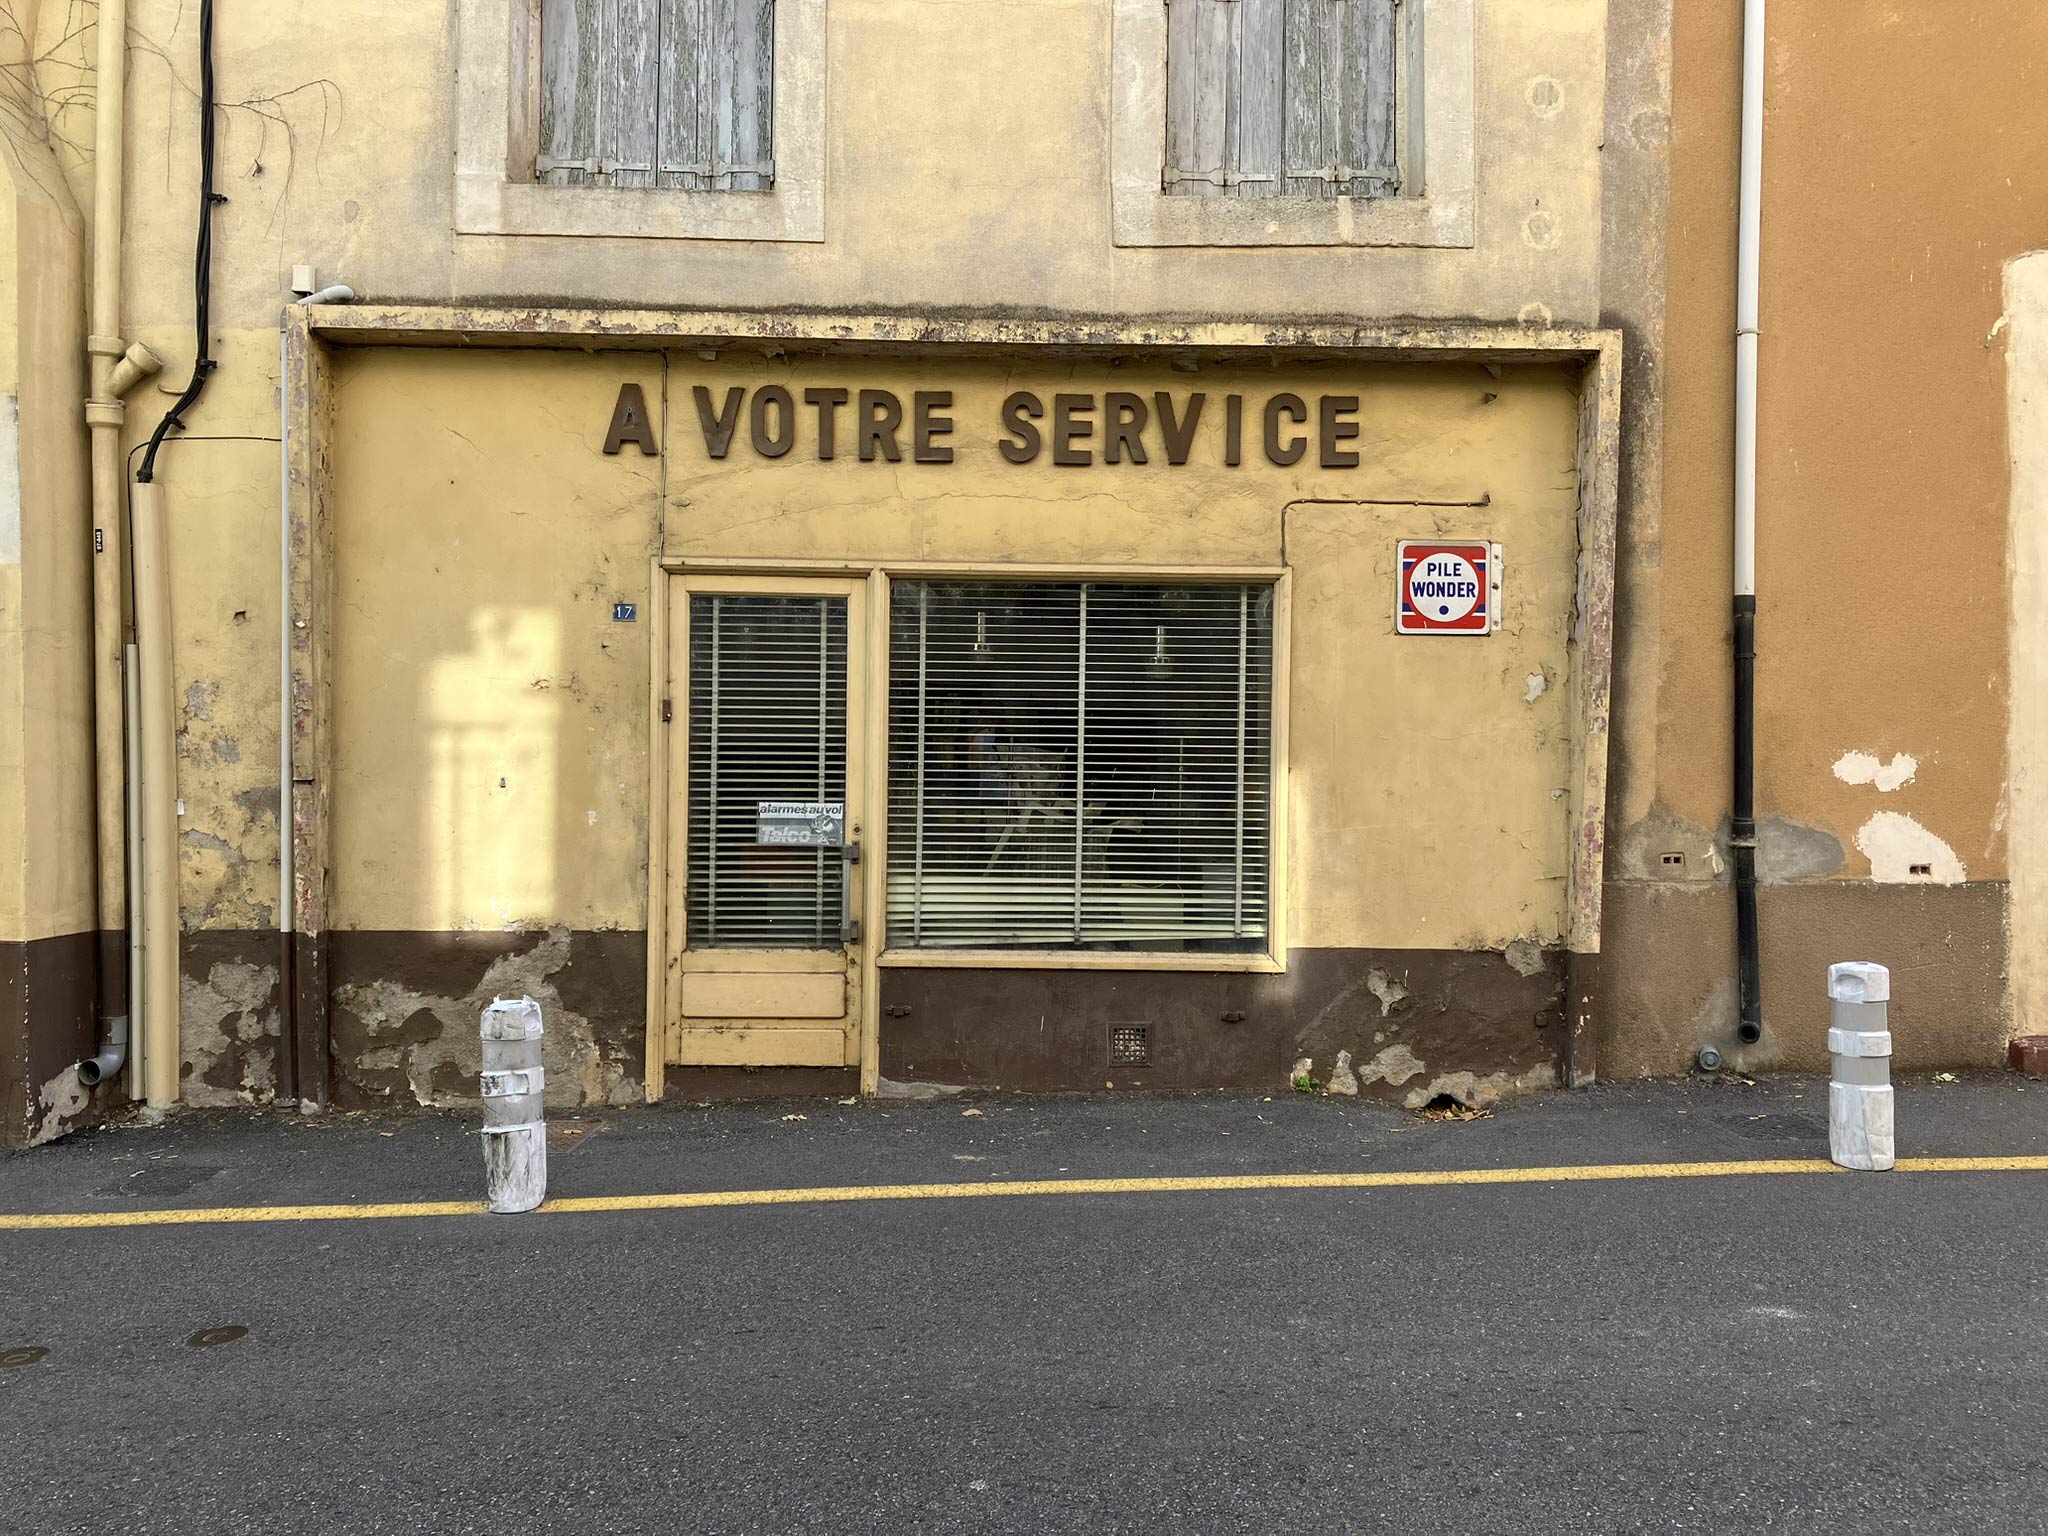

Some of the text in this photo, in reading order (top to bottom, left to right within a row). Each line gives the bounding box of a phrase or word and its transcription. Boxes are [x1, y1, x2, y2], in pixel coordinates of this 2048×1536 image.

[602, 382, 1360, 468] A VOTRE SERVICE
[1426, 562, 1462, 577] PILE
[1411, 581, 1476, 598] WONDER
[616, 605, 633, 618] 17
[759, 804, 808, 815] alarmes
[824, 804, 842, 815] vol
